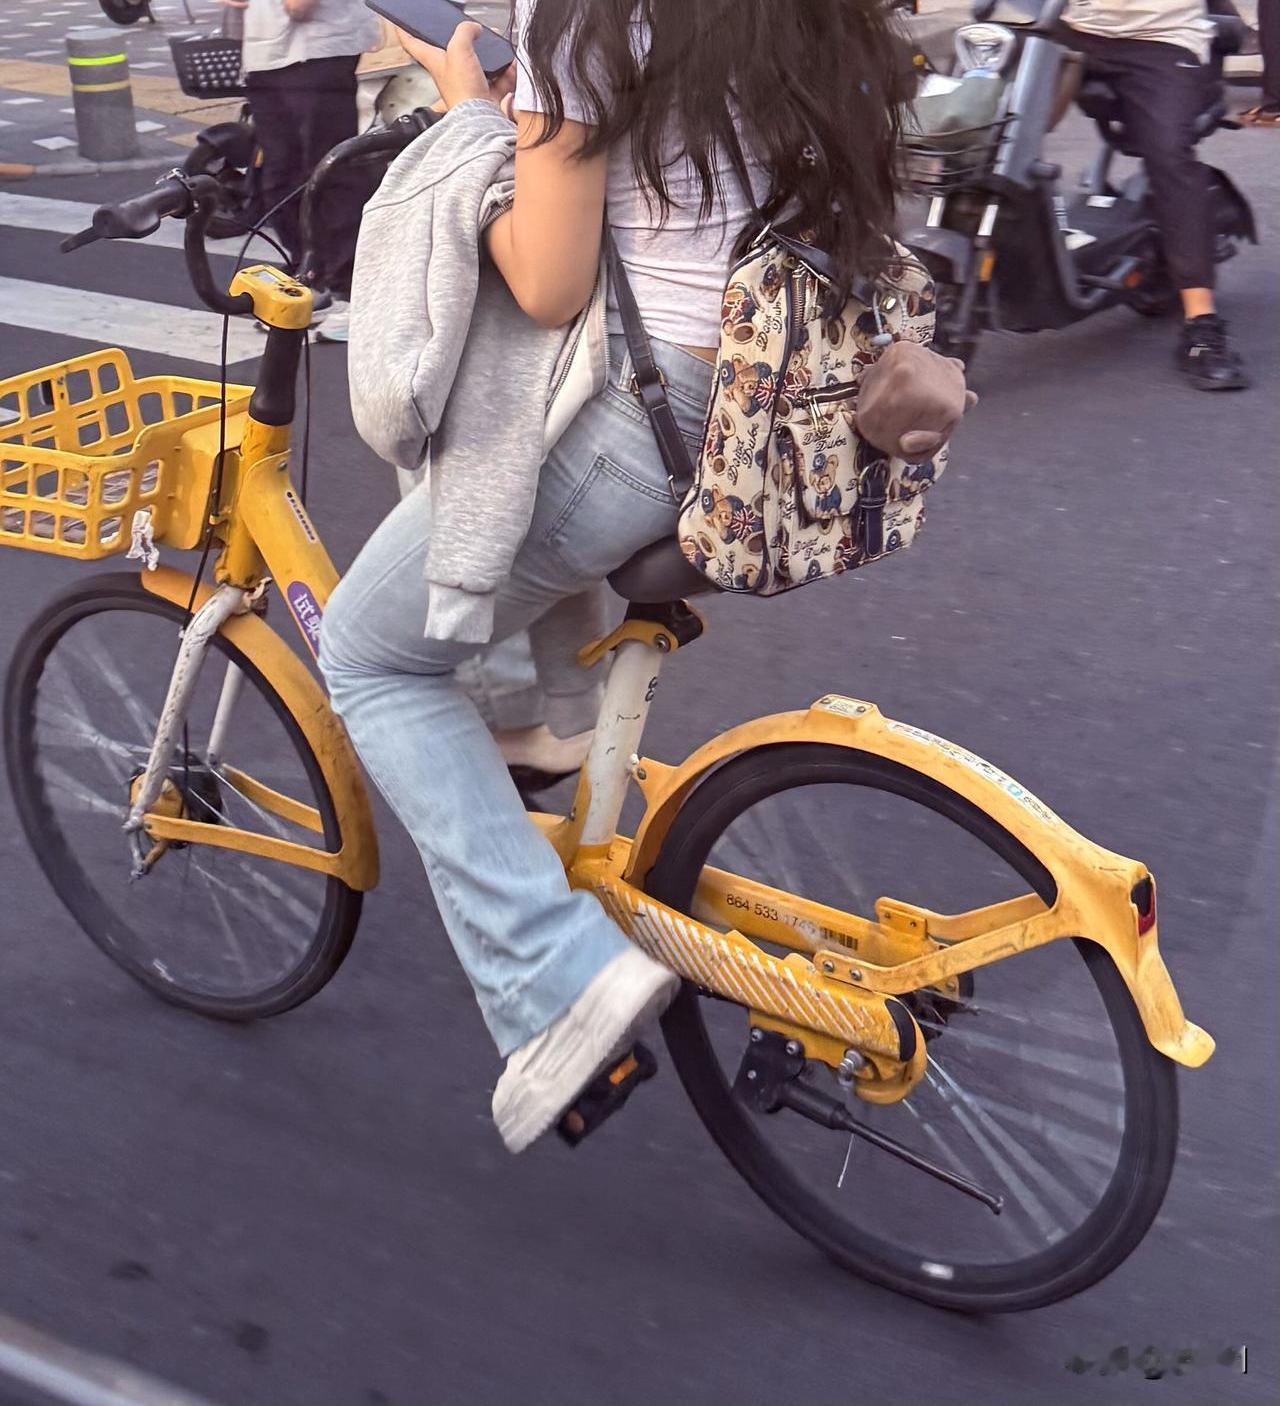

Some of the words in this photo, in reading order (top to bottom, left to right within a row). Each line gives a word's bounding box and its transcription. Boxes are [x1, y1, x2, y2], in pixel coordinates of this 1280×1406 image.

[741, 422, 760, 469] Duke
[726, 893, 750, 912] 864
[754, 902, 779, 922] 533
